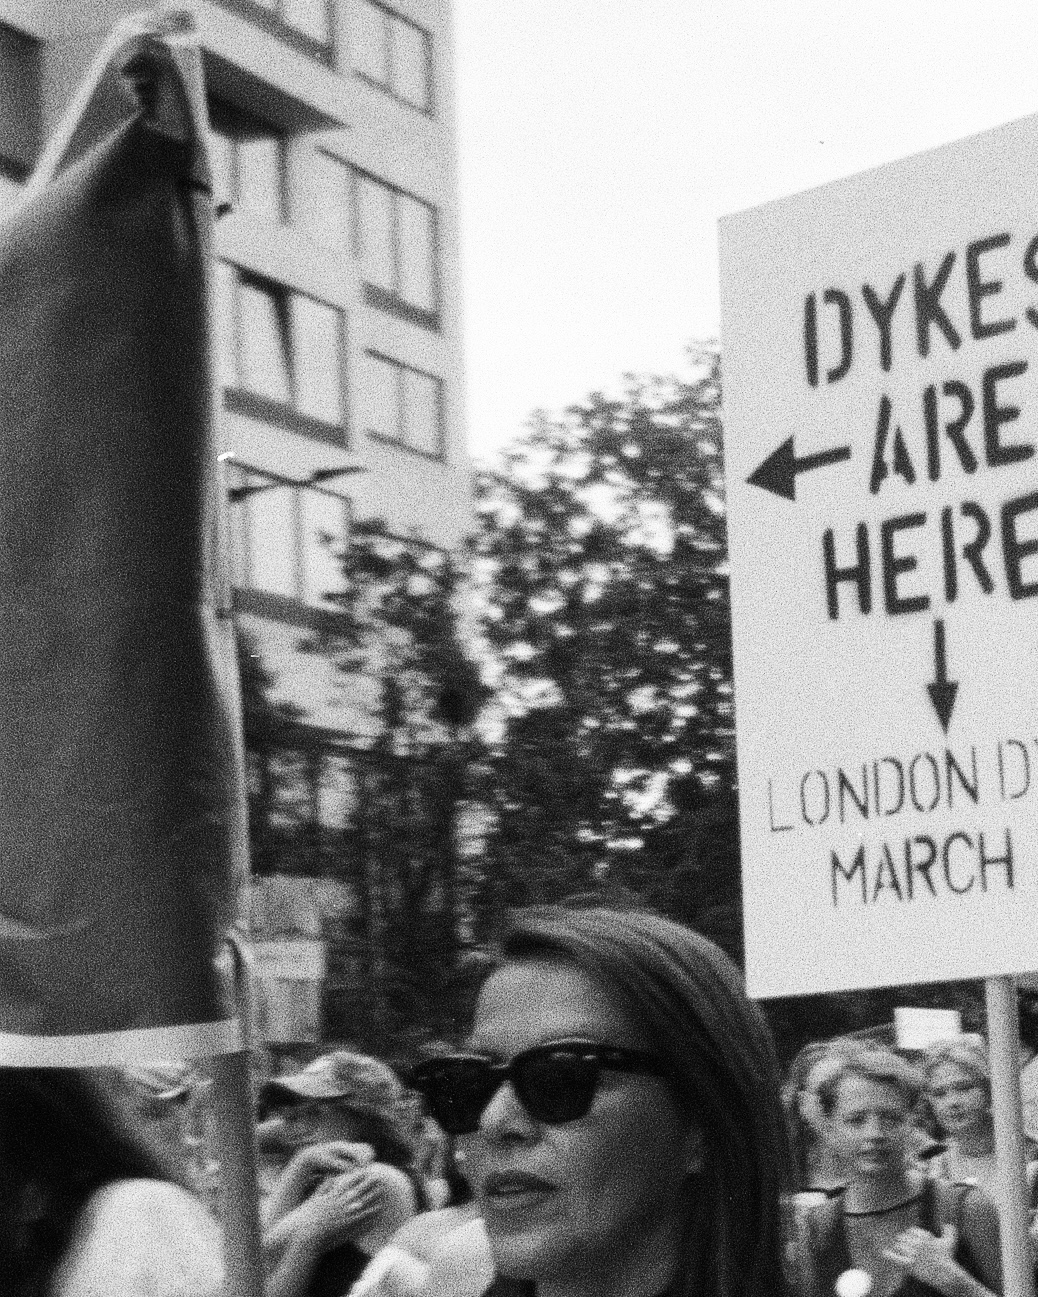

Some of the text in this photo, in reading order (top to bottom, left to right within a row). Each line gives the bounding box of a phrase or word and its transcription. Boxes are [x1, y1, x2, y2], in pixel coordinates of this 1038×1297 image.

[869, 360, 1036, 496] ARE
[768, 747, 980, 833] LONDON
[830, 828, 1015, 906] MARCH
